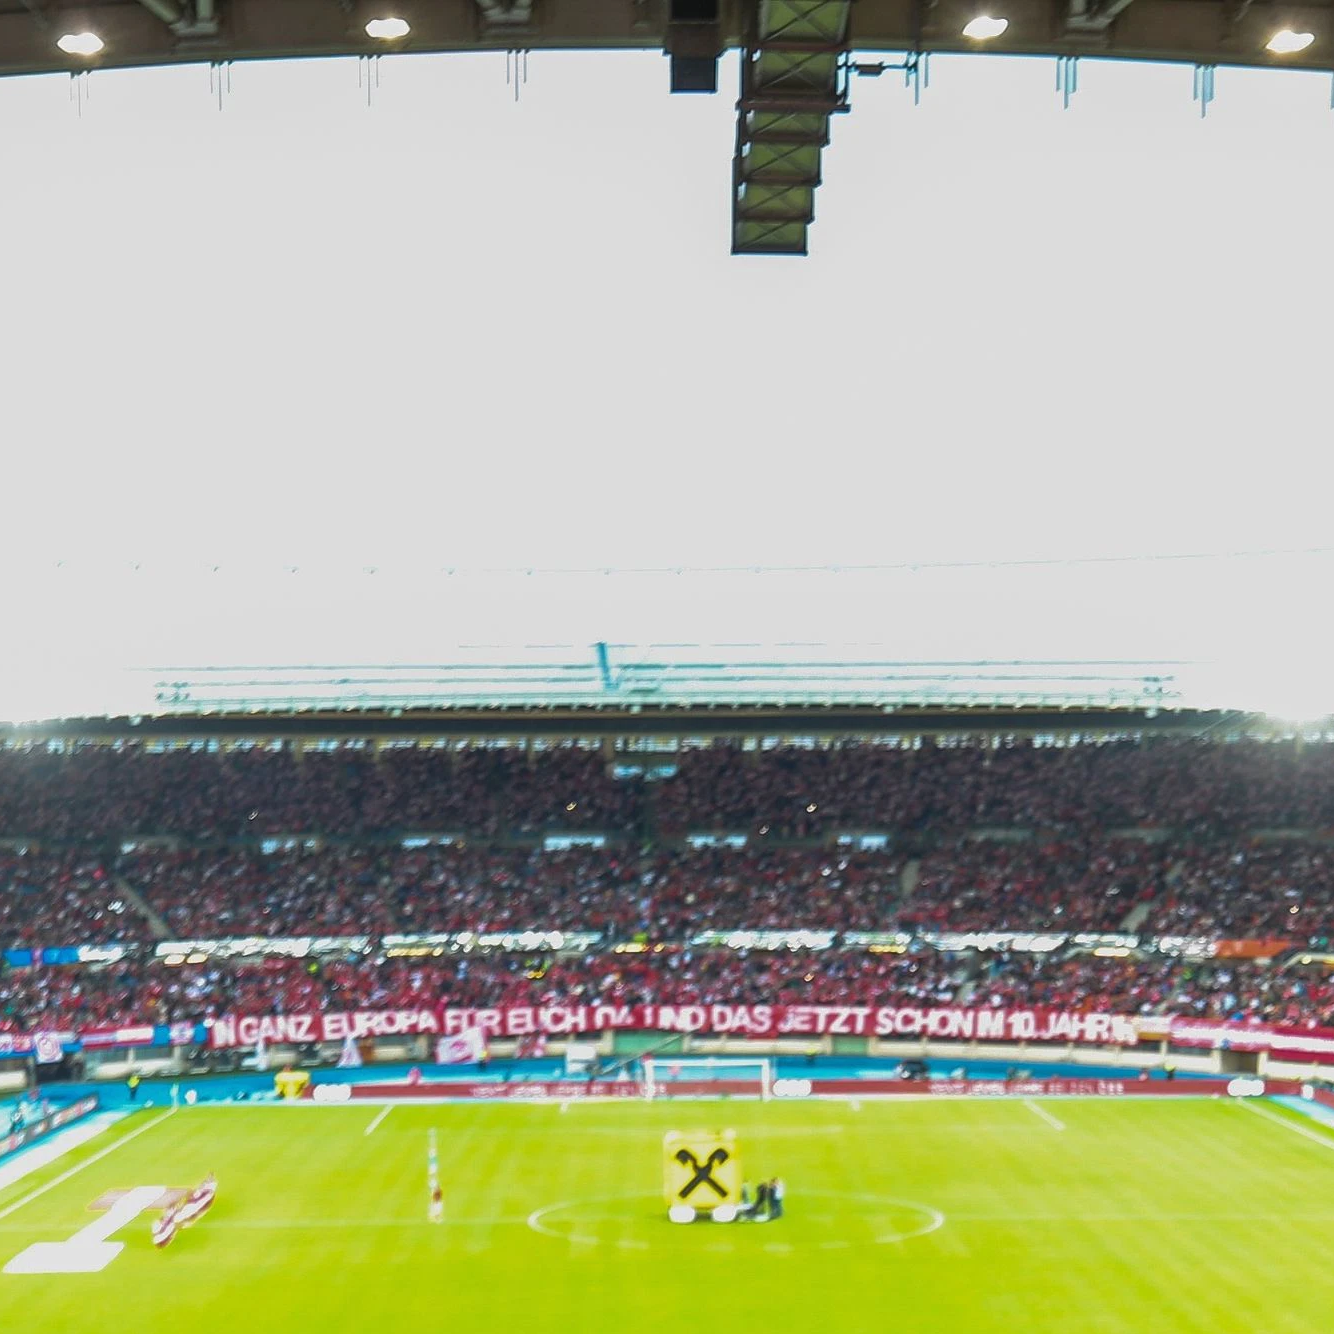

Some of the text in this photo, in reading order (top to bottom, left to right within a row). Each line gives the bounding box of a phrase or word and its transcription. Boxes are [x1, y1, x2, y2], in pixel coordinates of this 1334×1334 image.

[239, 1014, 317, 1043] GANZ
[322, 1009, 438, 1041] EUROPA
[506, 1006, 587, 1035] EUCH
[711, 1004, 772, 1033] DAS
[777, 1005, 871, 1033] JETZT
[875, 1006, 974, 1037] SCHON
